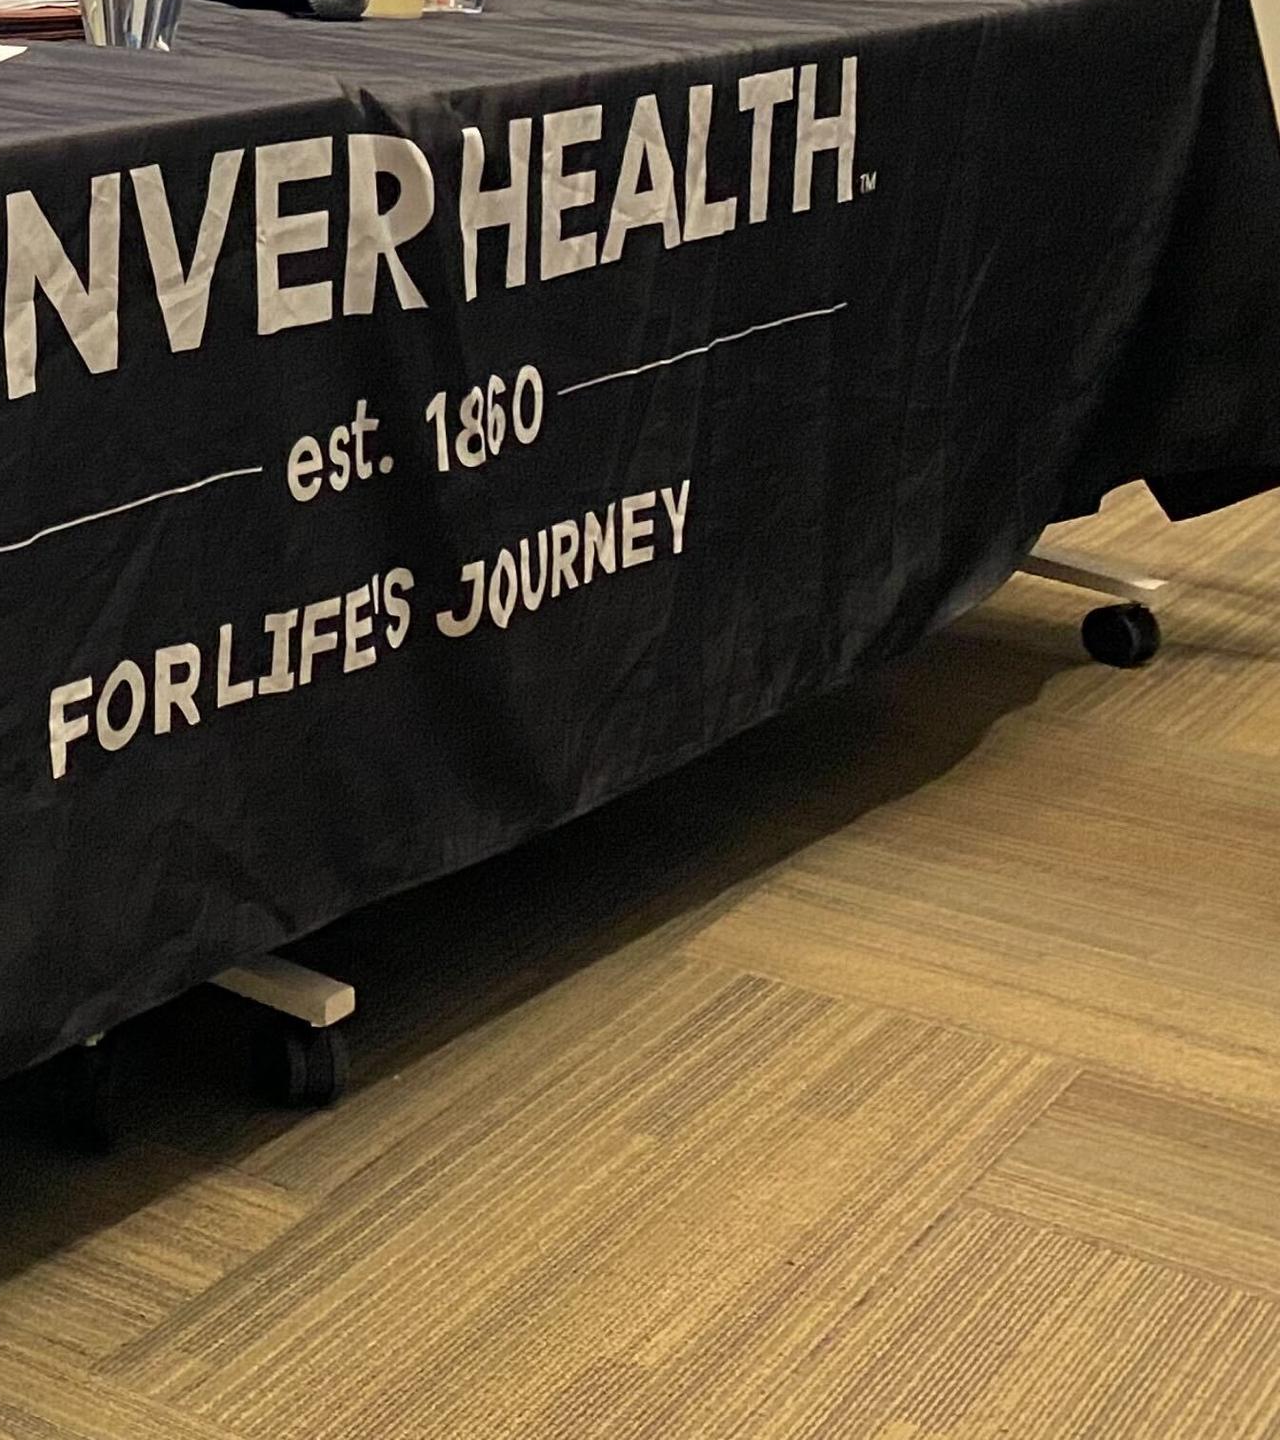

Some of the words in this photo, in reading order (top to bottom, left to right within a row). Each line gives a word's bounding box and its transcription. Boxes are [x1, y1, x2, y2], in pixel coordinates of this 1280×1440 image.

[459, 56, 858, 302] HEALTH
[286, 398, 393, 503] est.
[425, 364, 545, 472] 1860
[49, 643, 200, 779] FOR
[217, 567, 415, 708] LIFE'S
[436, 480, 690, 638] JOURNEY
